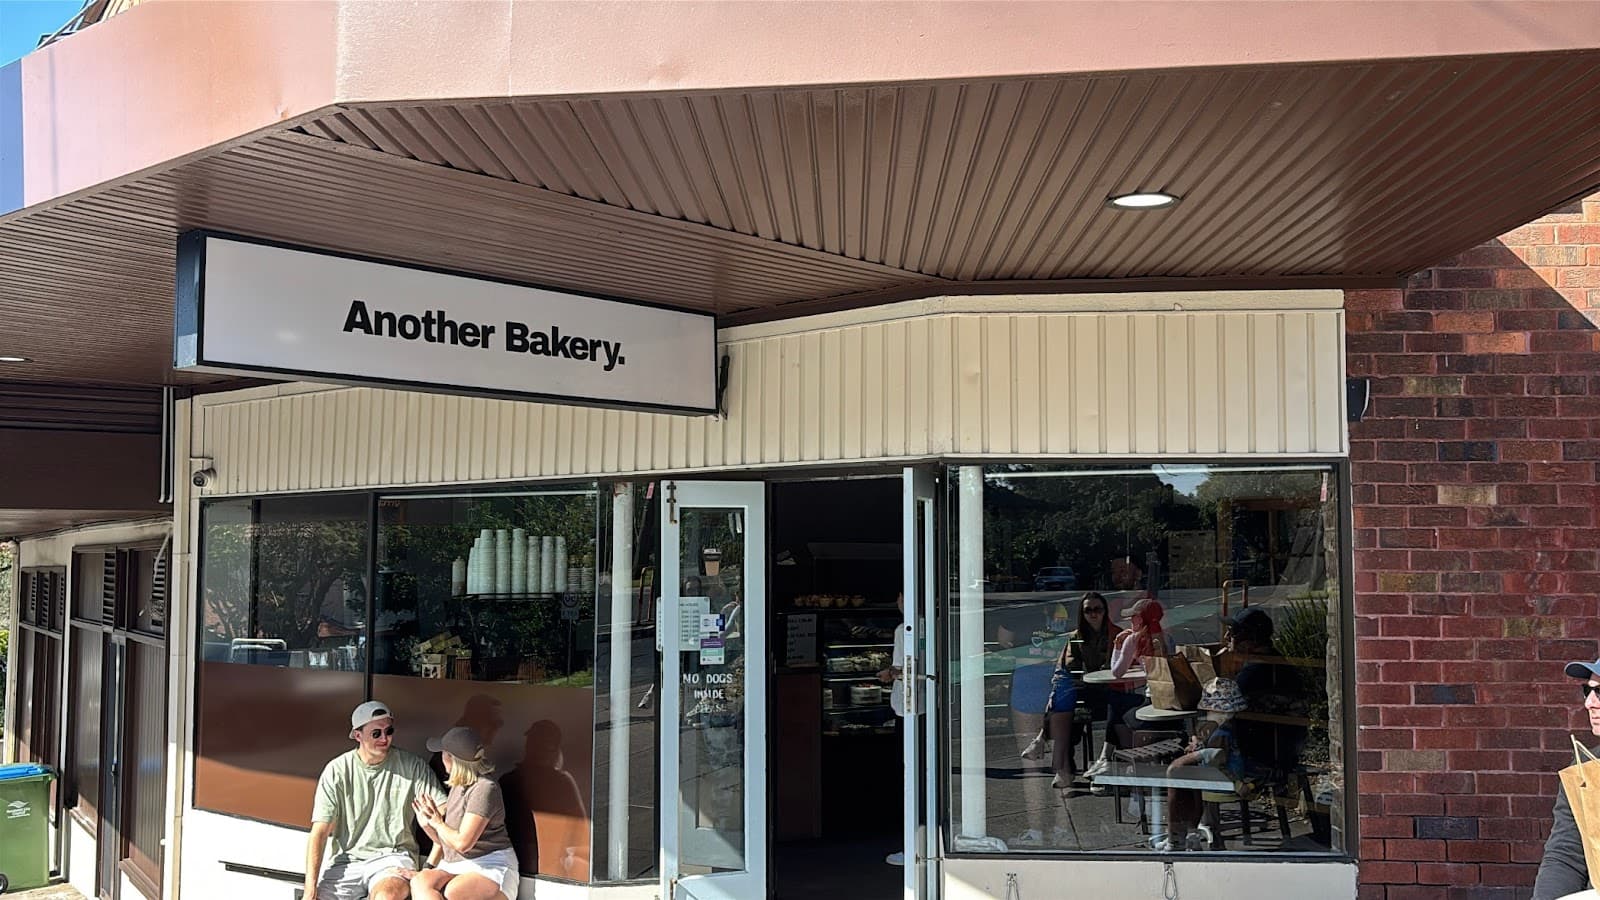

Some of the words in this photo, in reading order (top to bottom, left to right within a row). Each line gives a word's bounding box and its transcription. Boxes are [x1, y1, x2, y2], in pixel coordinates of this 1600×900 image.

[343, 300, 495, 349] Another
[505, 321, 625, 371] Bakery.
[682, 673, 699, 684] NO
[706, 673, 733, 684] DOGS
[694, 689, 725, 699] INSIDE
